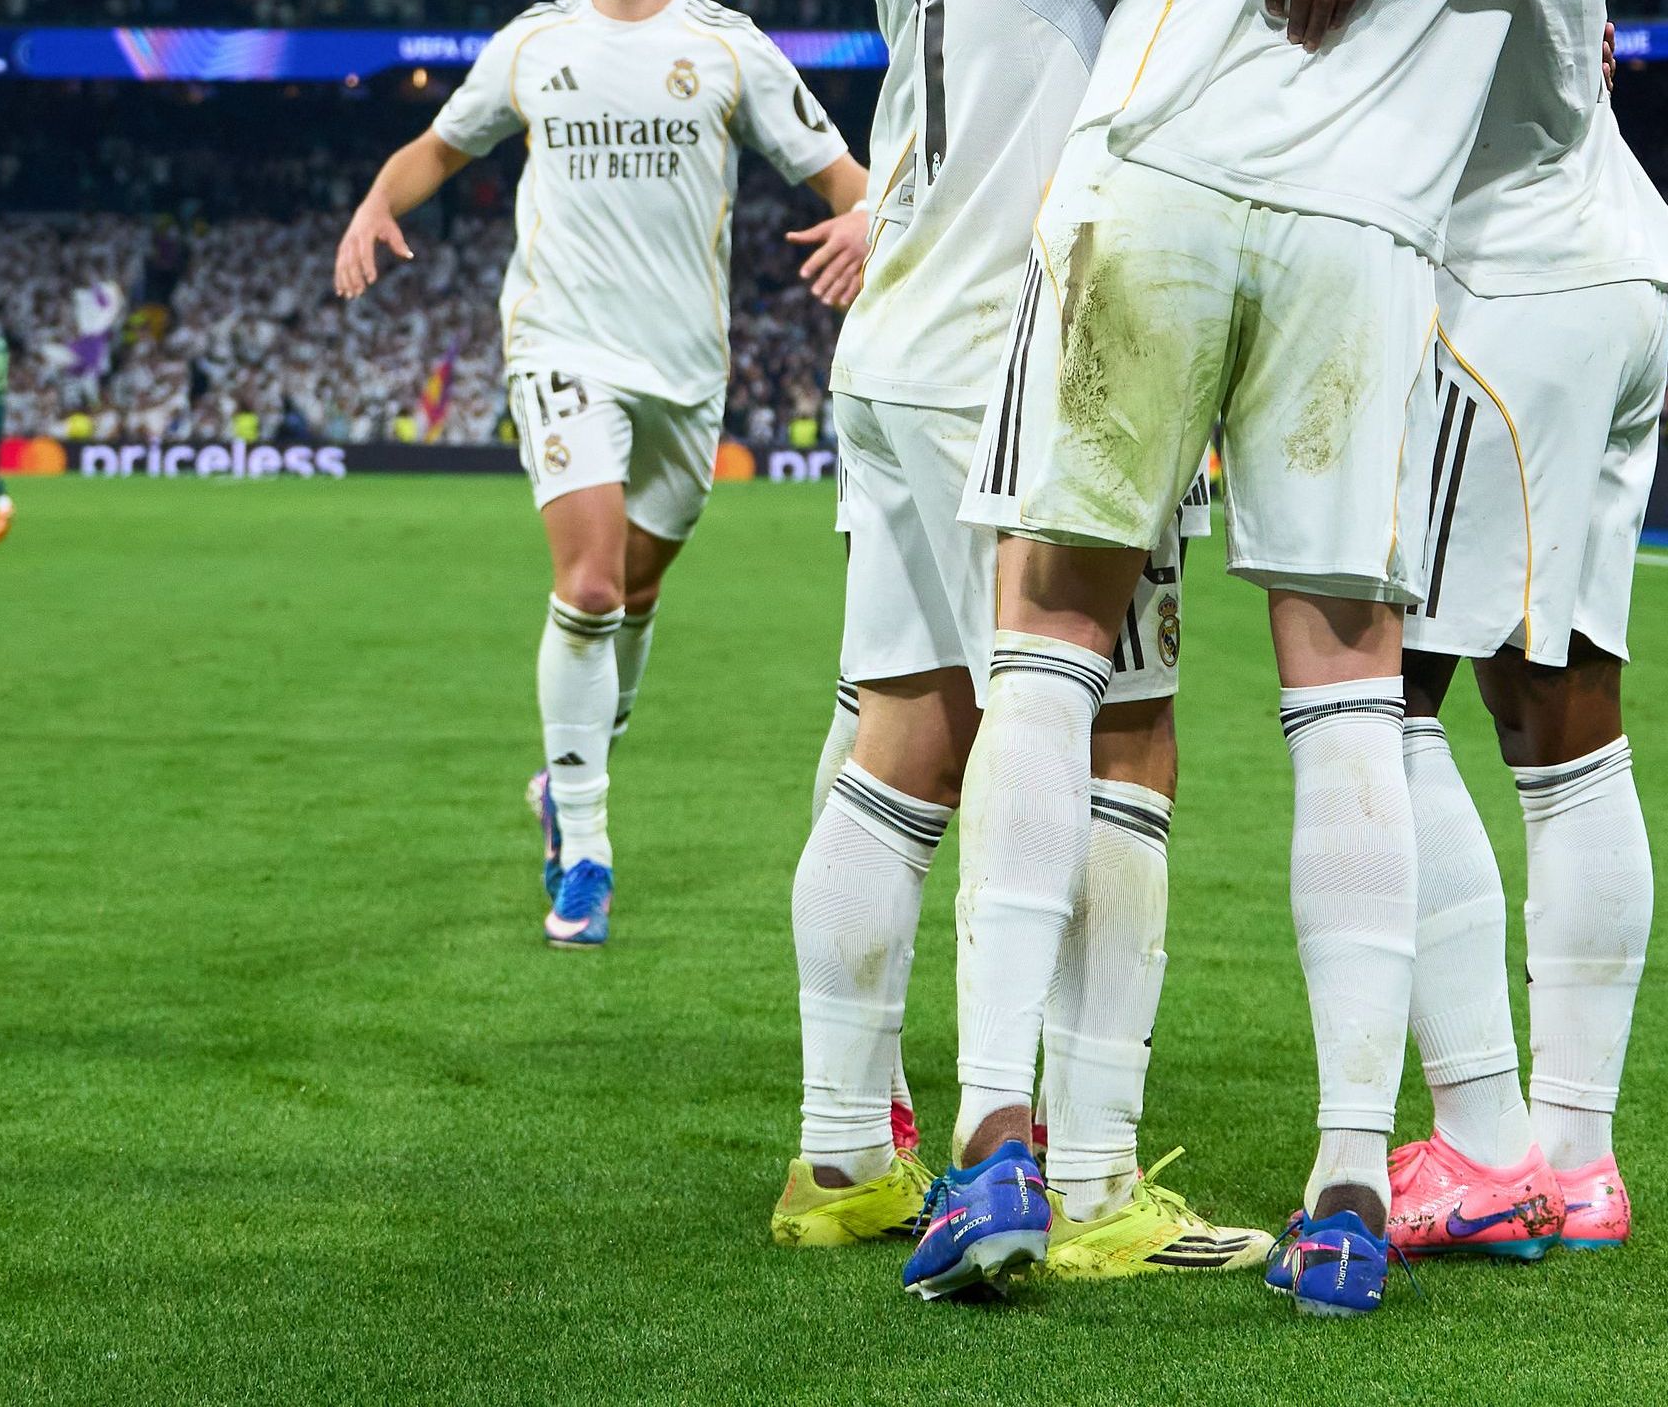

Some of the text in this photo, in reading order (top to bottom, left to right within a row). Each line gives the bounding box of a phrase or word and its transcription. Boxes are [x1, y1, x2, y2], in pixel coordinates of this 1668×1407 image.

[544, 112, 701, 149] Emirates
[569, 151, 680, 180] FLY BETTER
[81, 435, 347, 478] priceless
[1015, 1166, 1030, 1215] MERCURIAL
[1336, 1237, 1351, 1290] MERCURIAL
